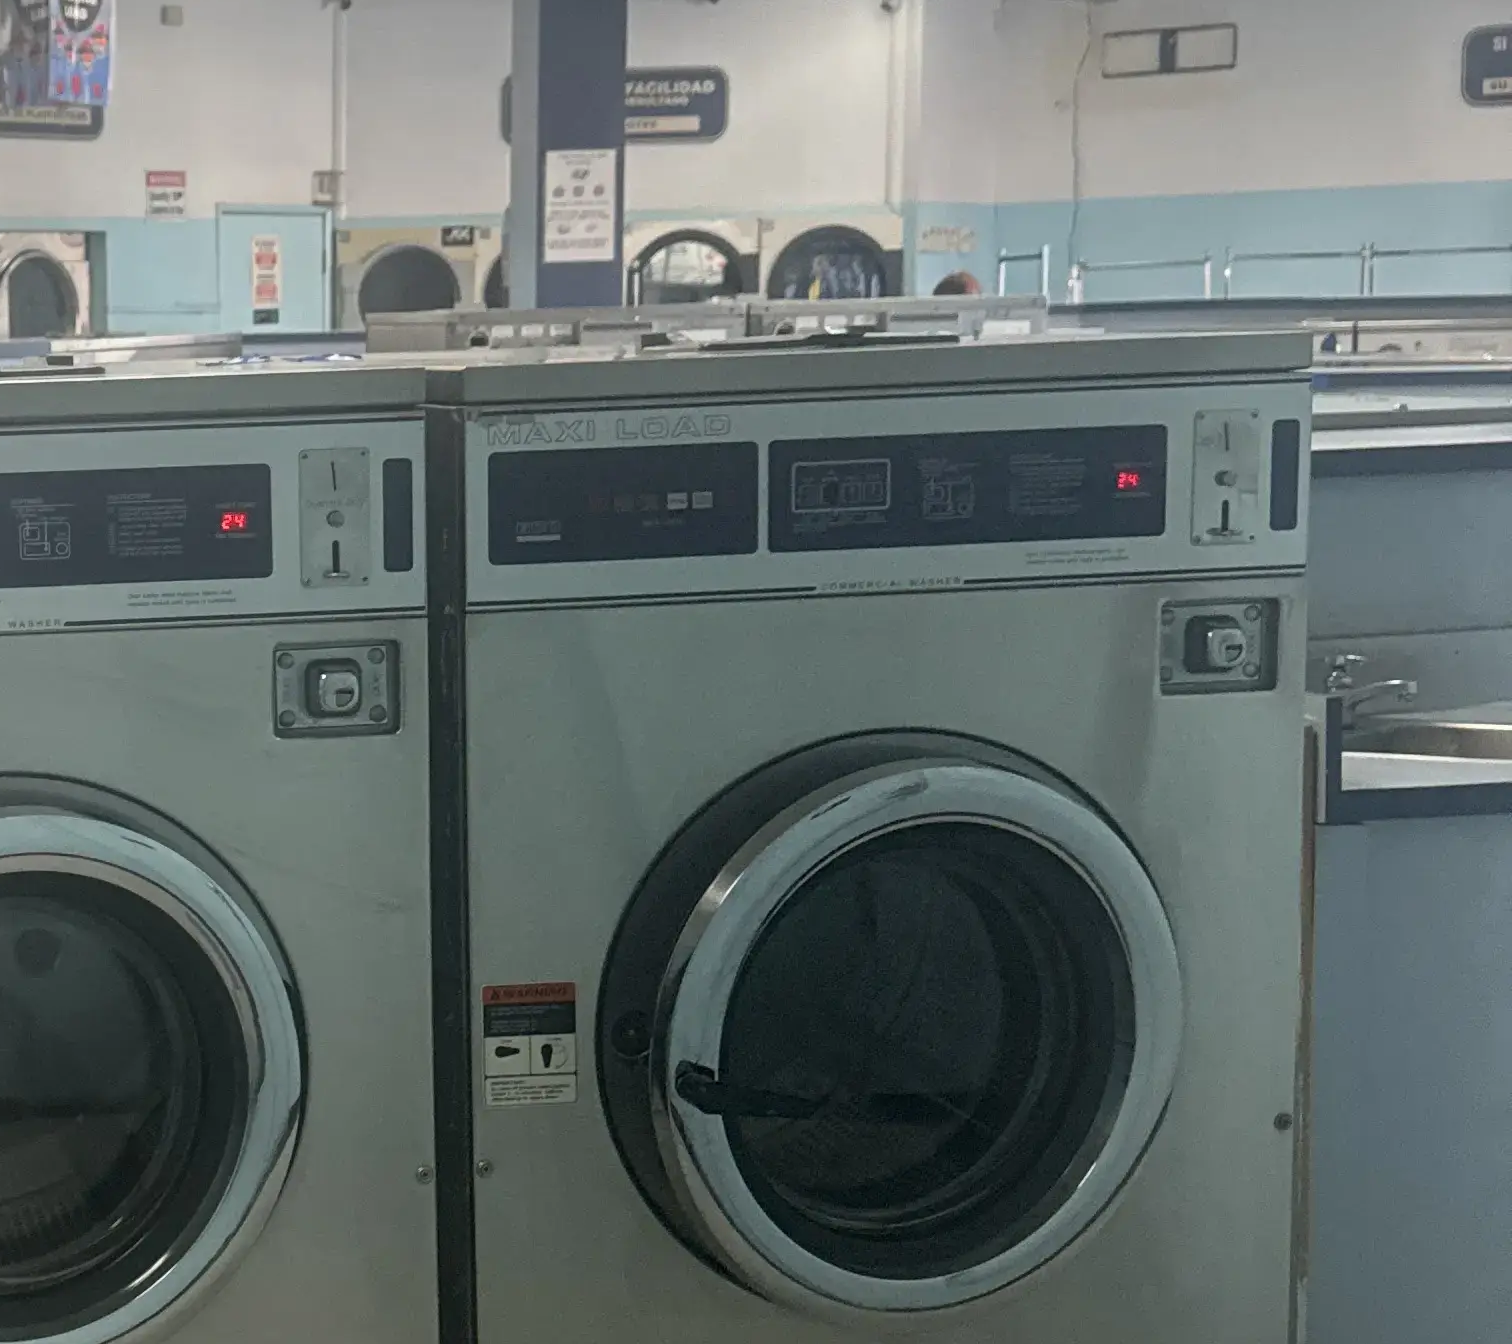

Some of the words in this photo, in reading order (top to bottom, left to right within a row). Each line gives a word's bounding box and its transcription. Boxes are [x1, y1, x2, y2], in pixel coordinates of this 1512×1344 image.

[489, 420, 596, 445] MAXI
[616, 414, 731, 440] LOAD
[1117, 471, 1139, 489] 24
[221, 513, 246, 531] 24
[9, 619, 62, 630] WASHER
